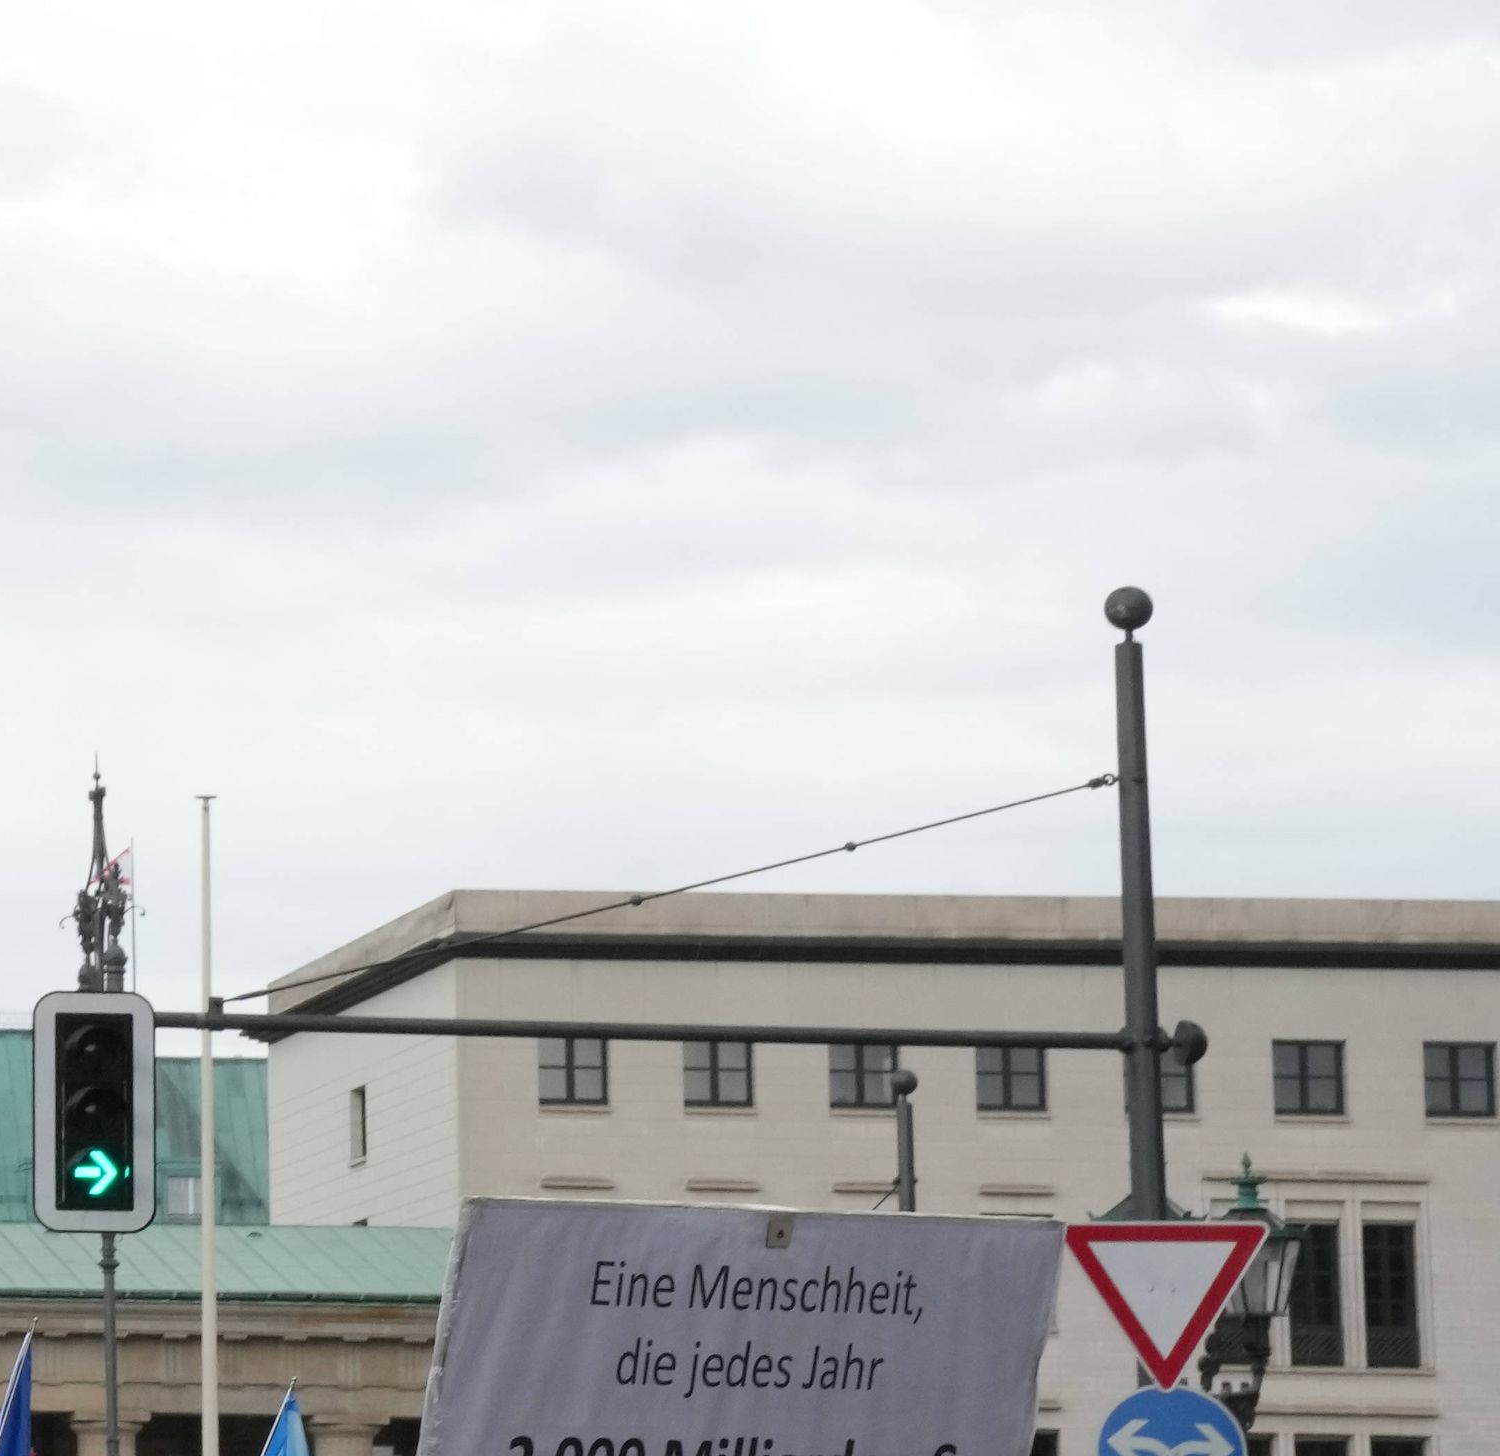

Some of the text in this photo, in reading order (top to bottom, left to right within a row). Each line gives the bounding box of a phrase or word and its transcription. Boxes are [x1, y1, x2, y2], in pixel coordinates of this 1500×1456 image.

[590, 1260, 925, 1324] Eine Menschheit,
[616, 1337, 884, 1399] die jedes Jahr
